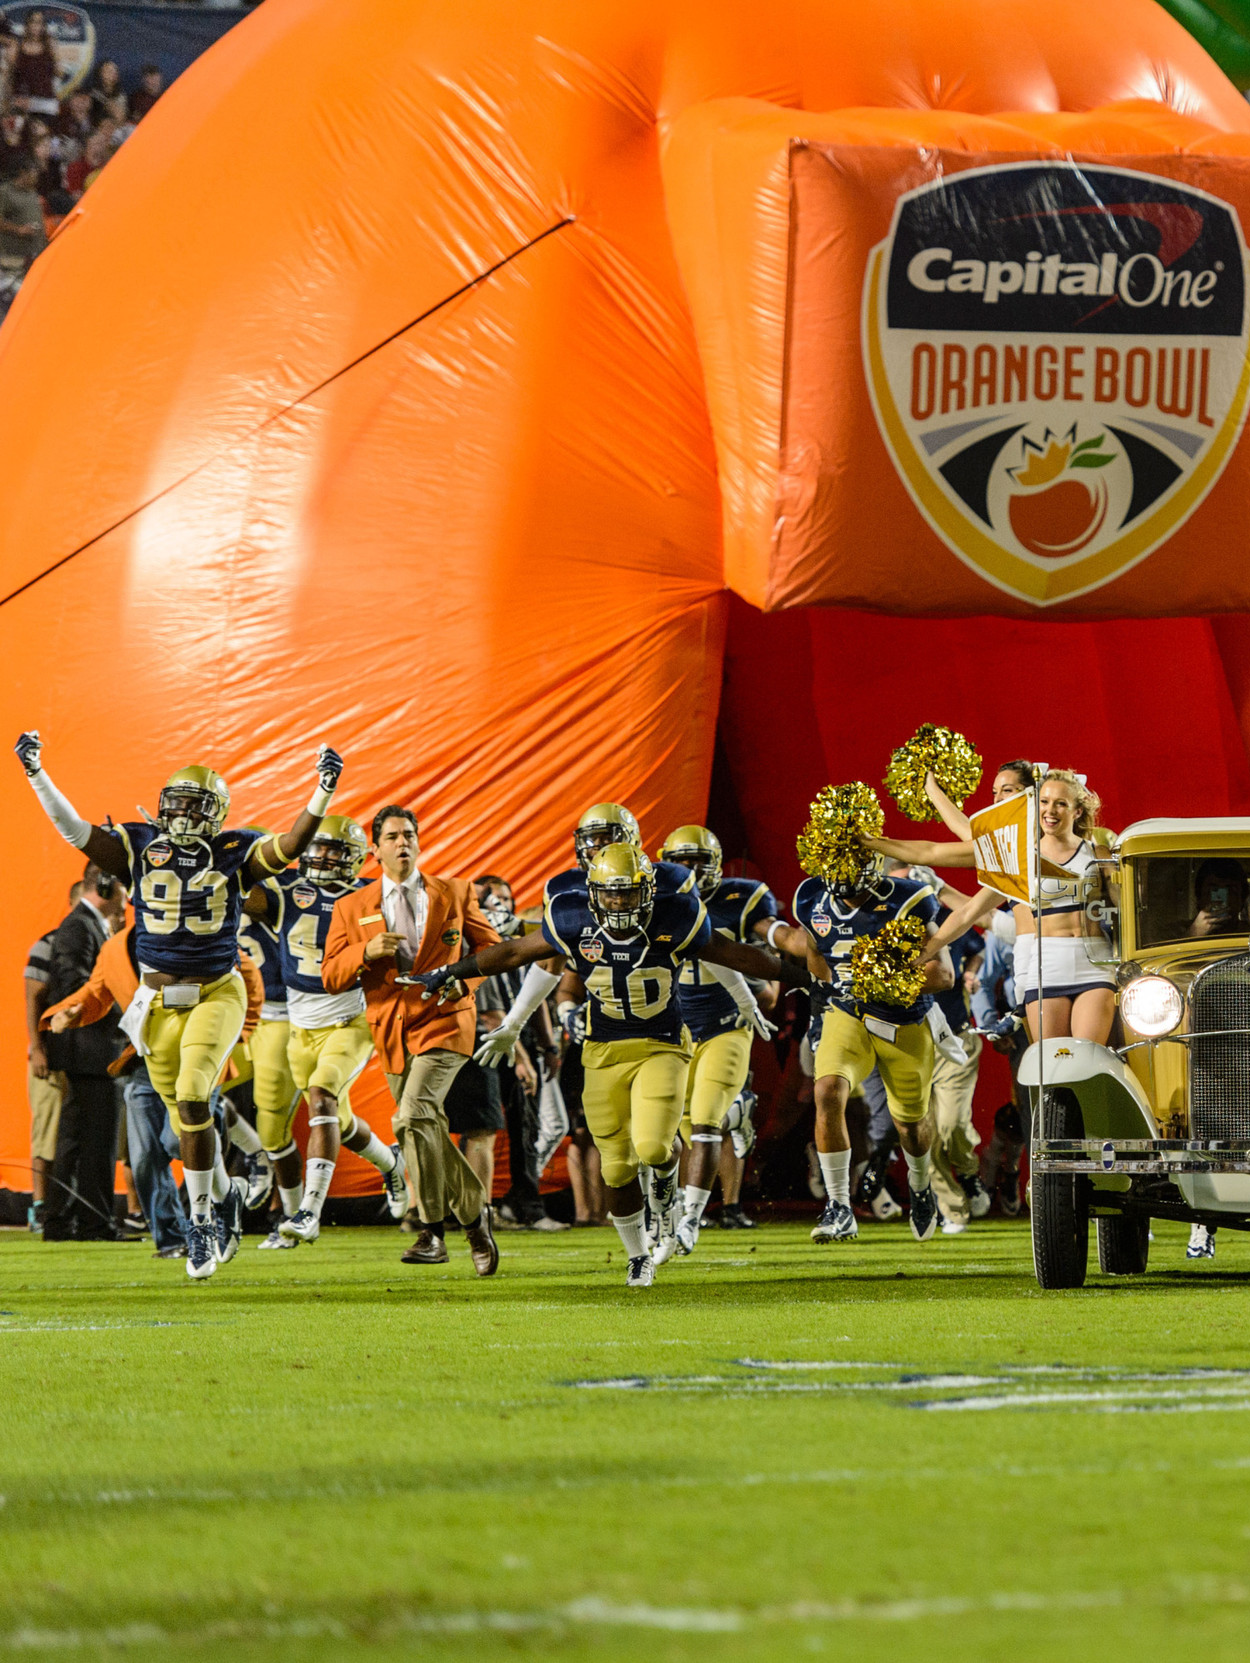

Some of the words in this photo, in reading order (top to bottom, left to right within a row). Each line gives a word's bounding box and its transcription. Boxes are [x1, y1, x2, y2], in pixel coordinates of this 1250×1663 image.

[911, 341, 1085, 422] ORANGE
[1093, 346, 1215, 427] BOWL
[177, 857, 198, 867] TECH
[140, 869, 229, 936] 93
[1086, 900, 1119, 925] GT
[584, 966, 673, 1020] 40
